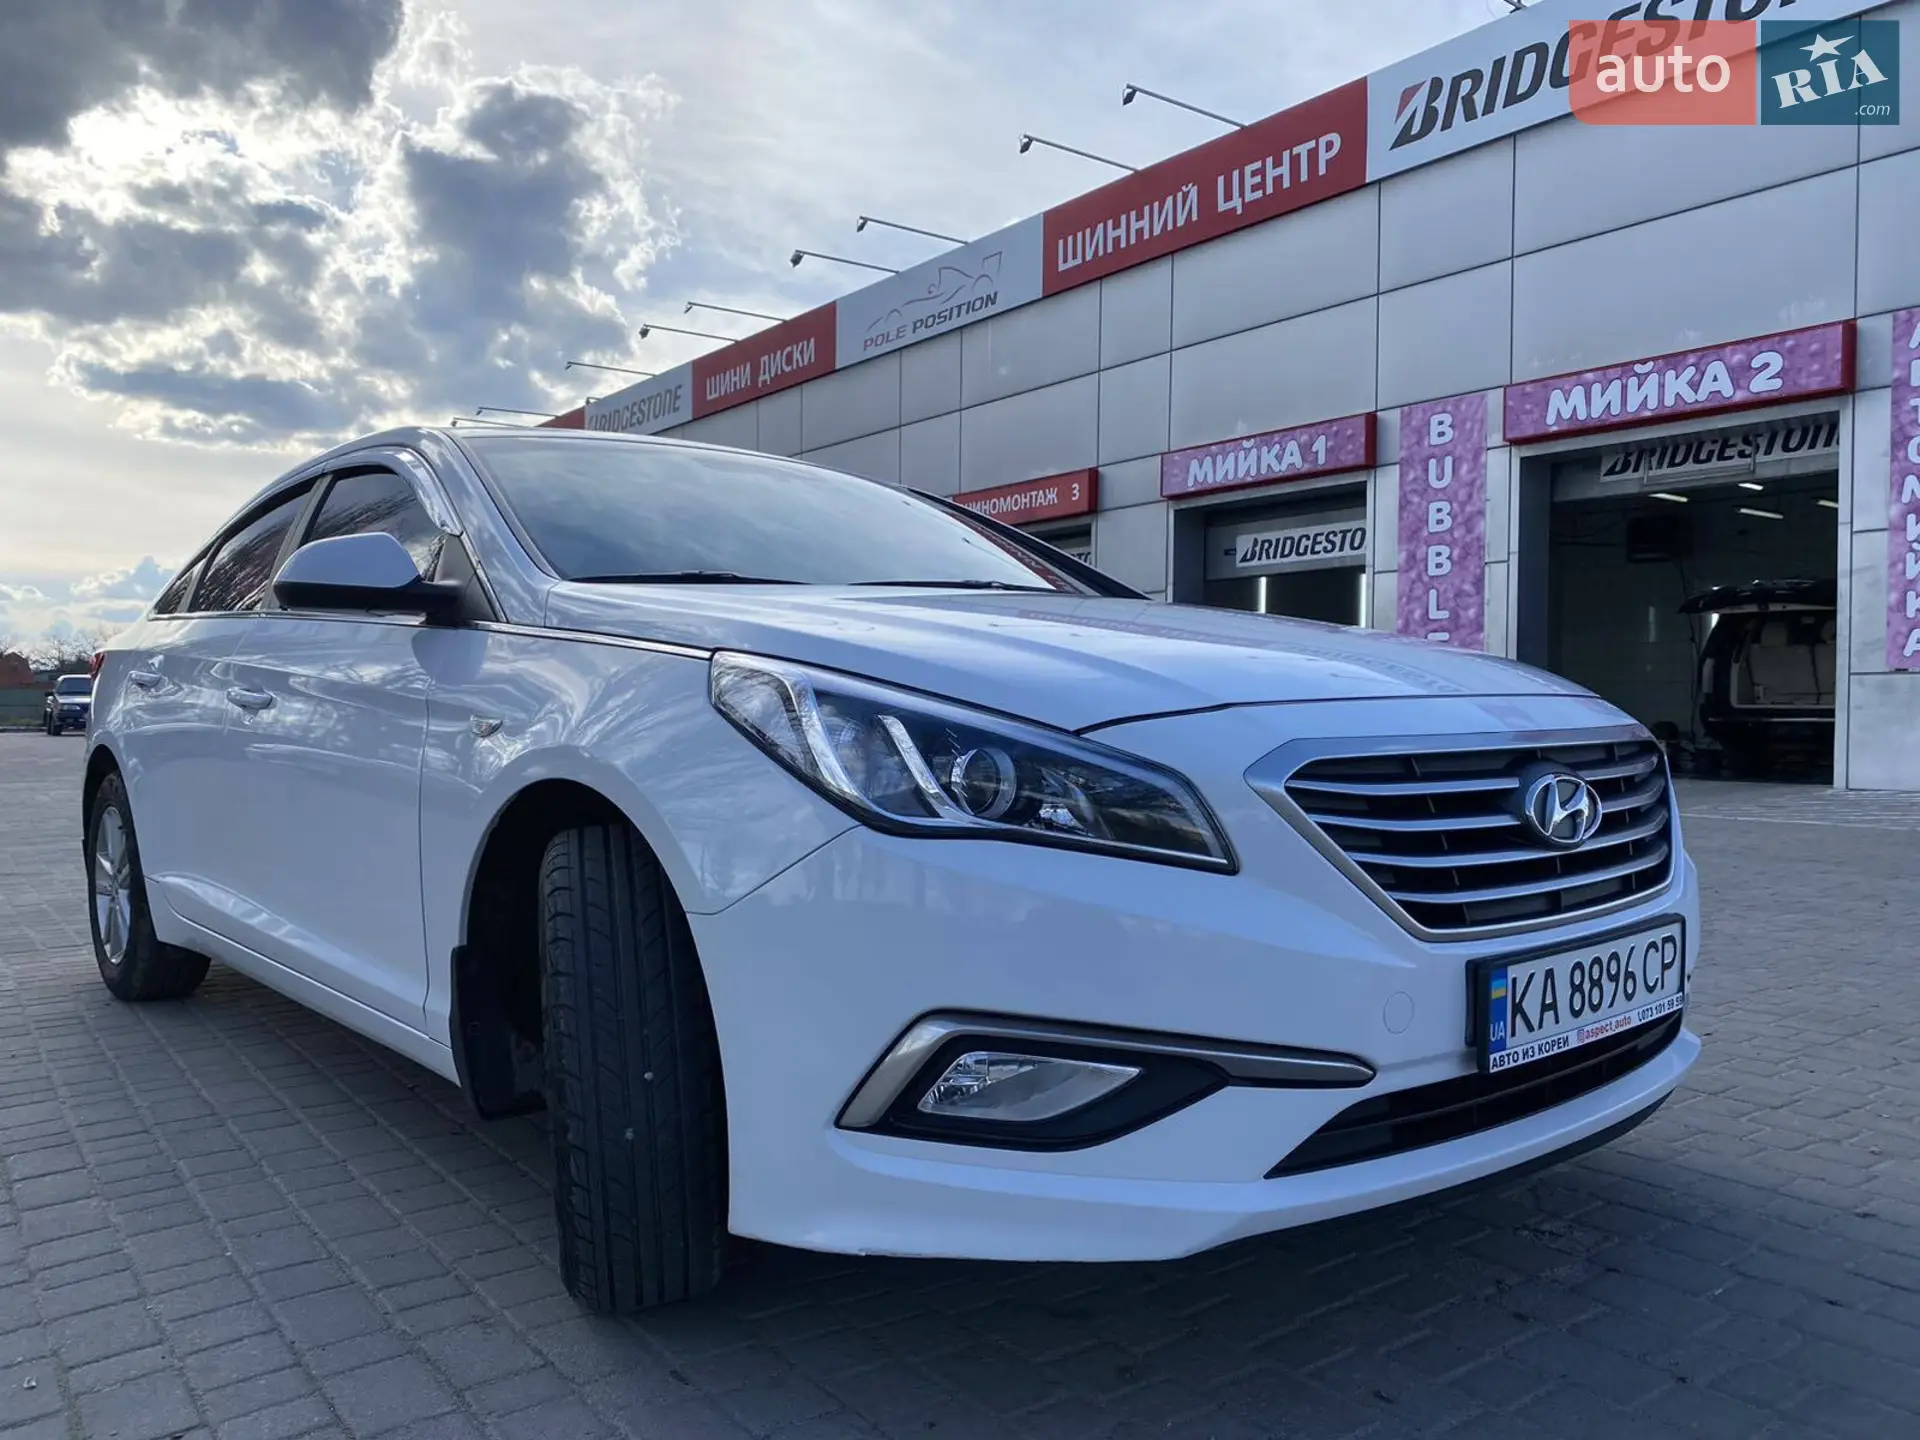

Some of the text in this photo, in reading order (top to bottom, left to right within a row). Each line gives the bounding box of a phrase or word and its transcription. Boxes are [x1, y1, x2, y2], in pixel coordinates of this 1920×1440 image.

[1057, 132, 1342, 272] ШИННИЙ ЦЕНТР
[863, 291, 998, 351] POLE POSITION
[706, 337, 815, 401] ШИНИ ДИСКИ
[1546, 351, 1785, 426] МИЙКА 2
[588, 384, 683, 431] BRIDGESTONE
[1187, 435, 1327, 487] МИЙКА 1
[1603, 423, 1840, 476] BRIDGESTON
[1072, 483, 1080, 500] 3
[1427, 413, 1453, 641] BUBBL
[1510, 933, 1678, 1037] KA 8896 CP
[1490, 1021, 1505, 1041] UA
[1491, 1050, 1519, 1070] АВТО
[1522, 1046, 1535, 1060] ИЗ
